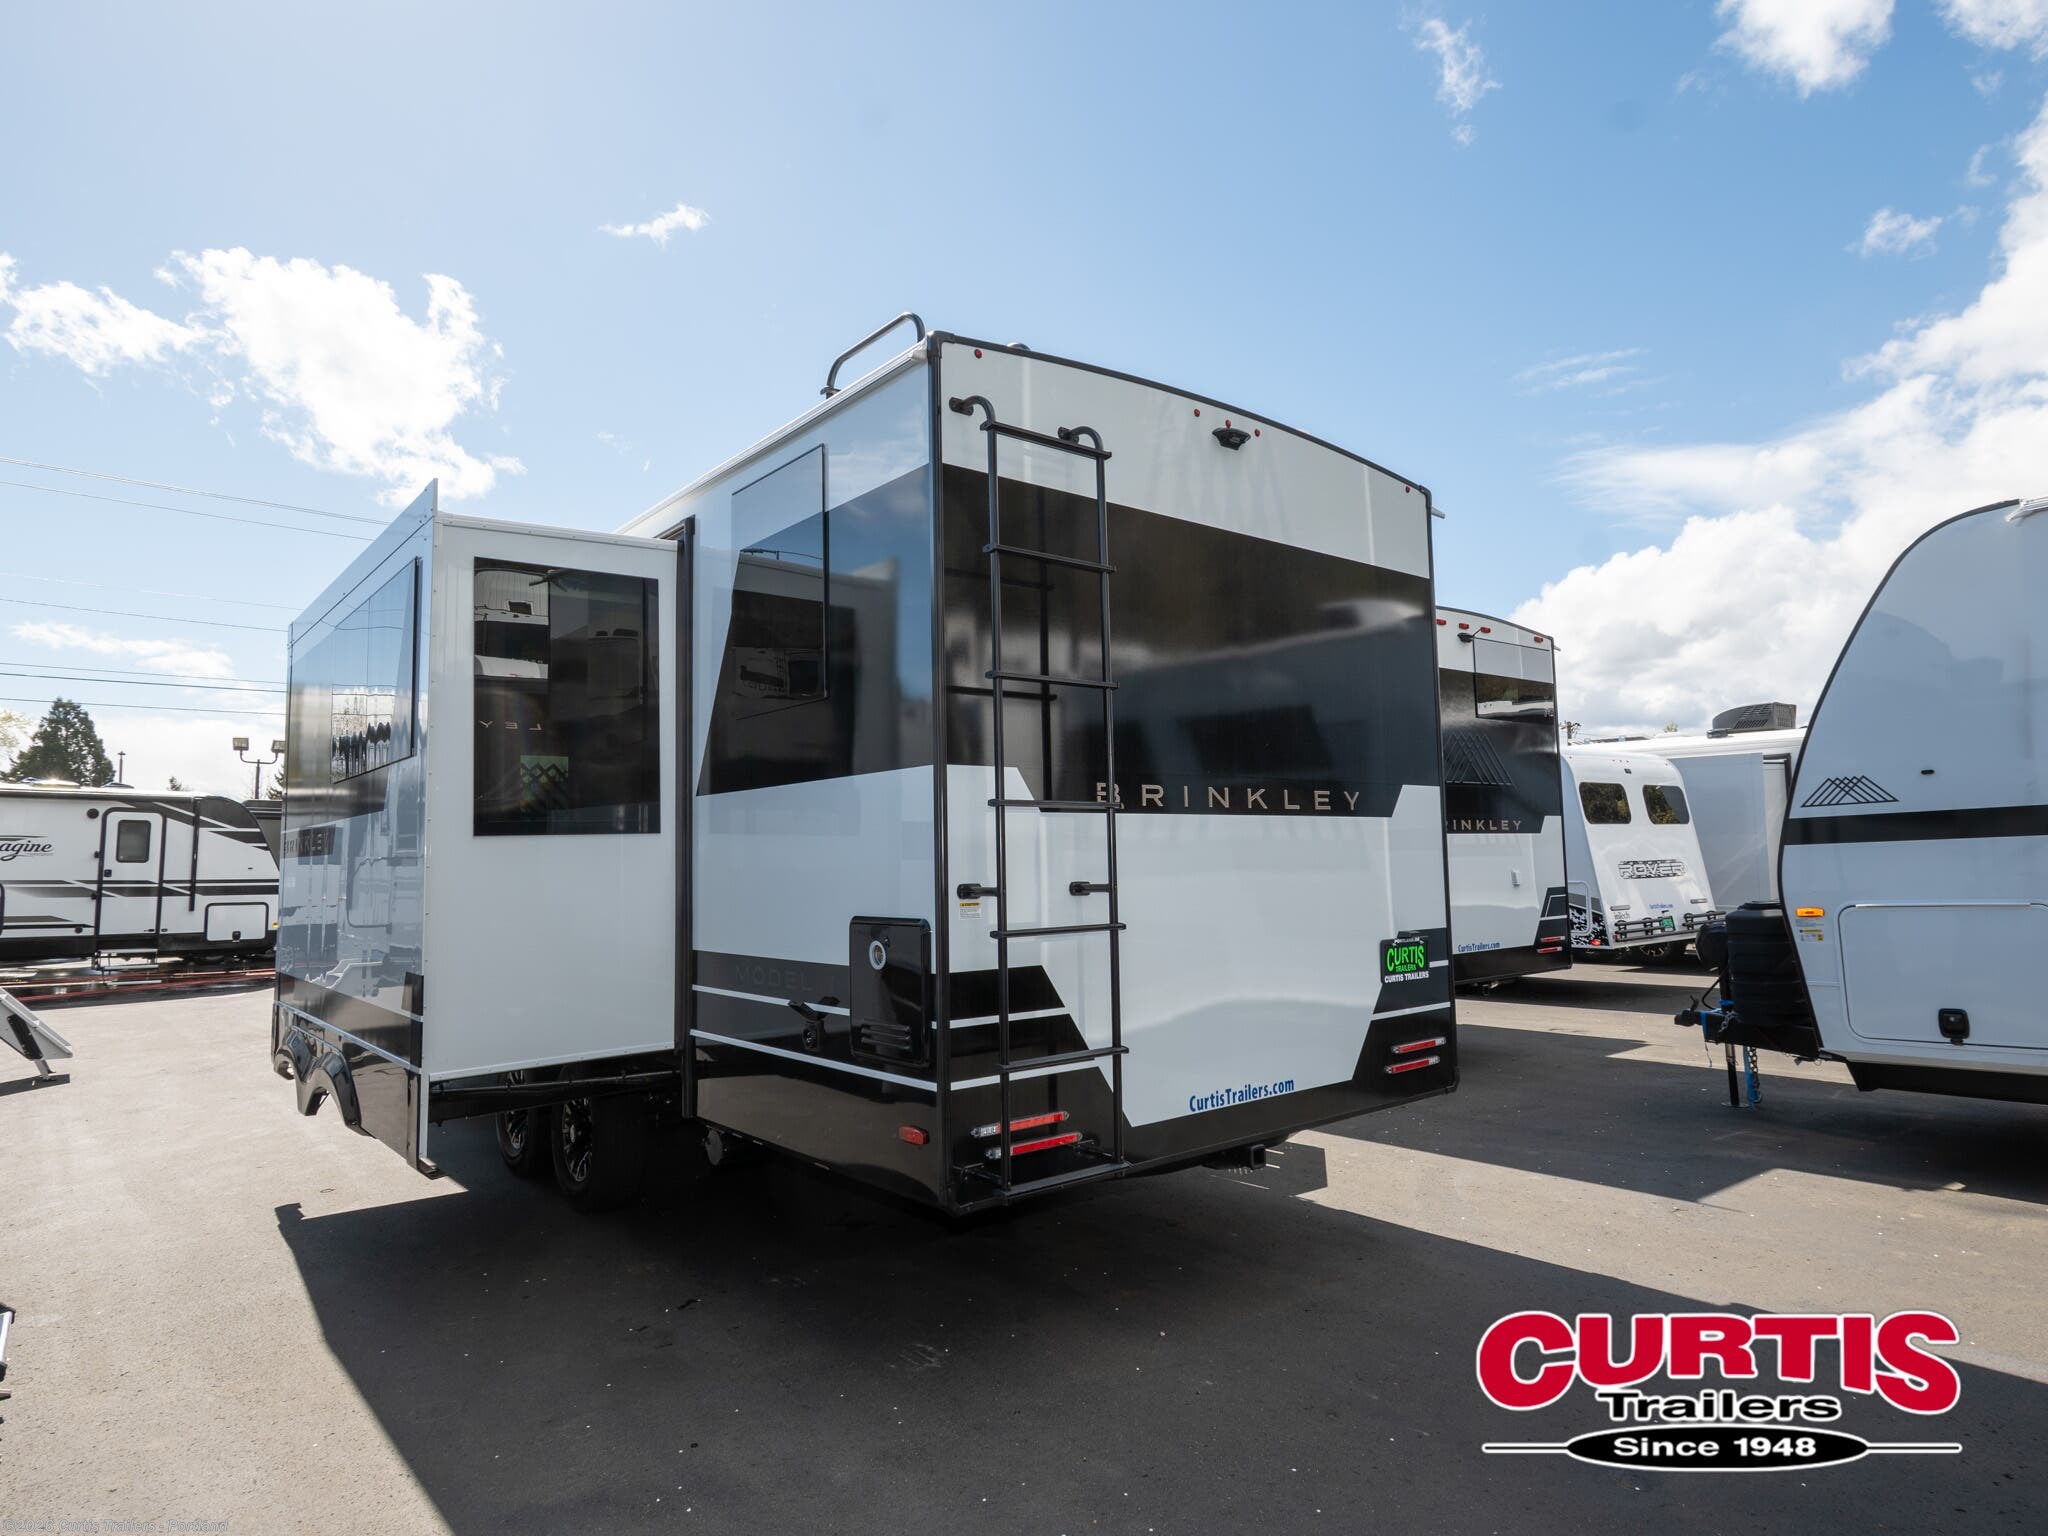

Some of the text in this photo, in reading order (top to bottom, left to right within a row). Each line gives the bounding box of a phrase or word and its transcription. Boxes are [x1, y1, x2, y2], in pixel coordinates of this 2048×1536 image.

[1095, 781, 1360, 811] BRINKLEY
[1446, 819, 1521, 831] INKLEY
[1618, 860, 1687, 879] ROVER
[1387, 945, 1424, 972] CURTIS
[1385, 971, 1429, 983] CURTIS TRAILERS
[1396, 964, 1417, 973] TRAILERS
[1189, 1079, 1295, 1112] CurtisTrailers.com
